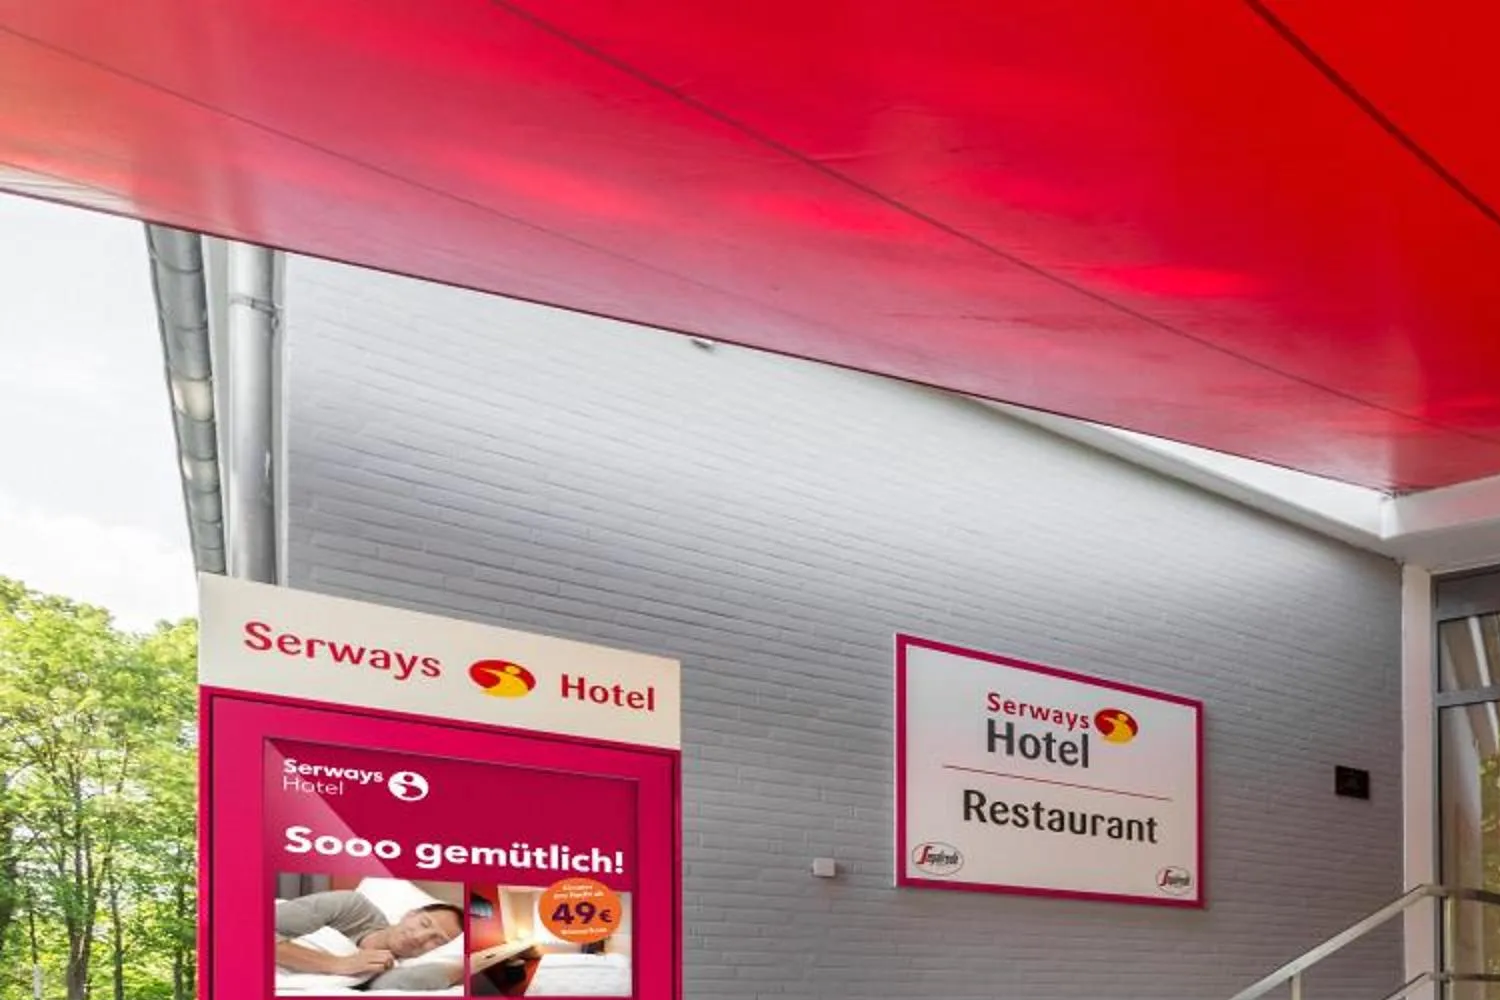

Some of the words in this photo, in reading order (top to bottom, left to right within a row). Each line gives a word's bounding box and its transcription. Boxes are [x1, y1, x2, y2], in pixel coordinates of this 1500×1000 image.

[244, 621, 441, 681] Serways
[560, 674, 655, 711] Hotel
[987, 692, 1089, 731] Serways
[987, 718, 1089, 768] Hotel
[283, 757, 383, 784] Serways
[283, 775, 344, 796] Hotel
[963, 789, 1158, 843] Restaurant
[284, 826, 402, 860] Sooo
[415, 841, 624, 874] gemütlich!
